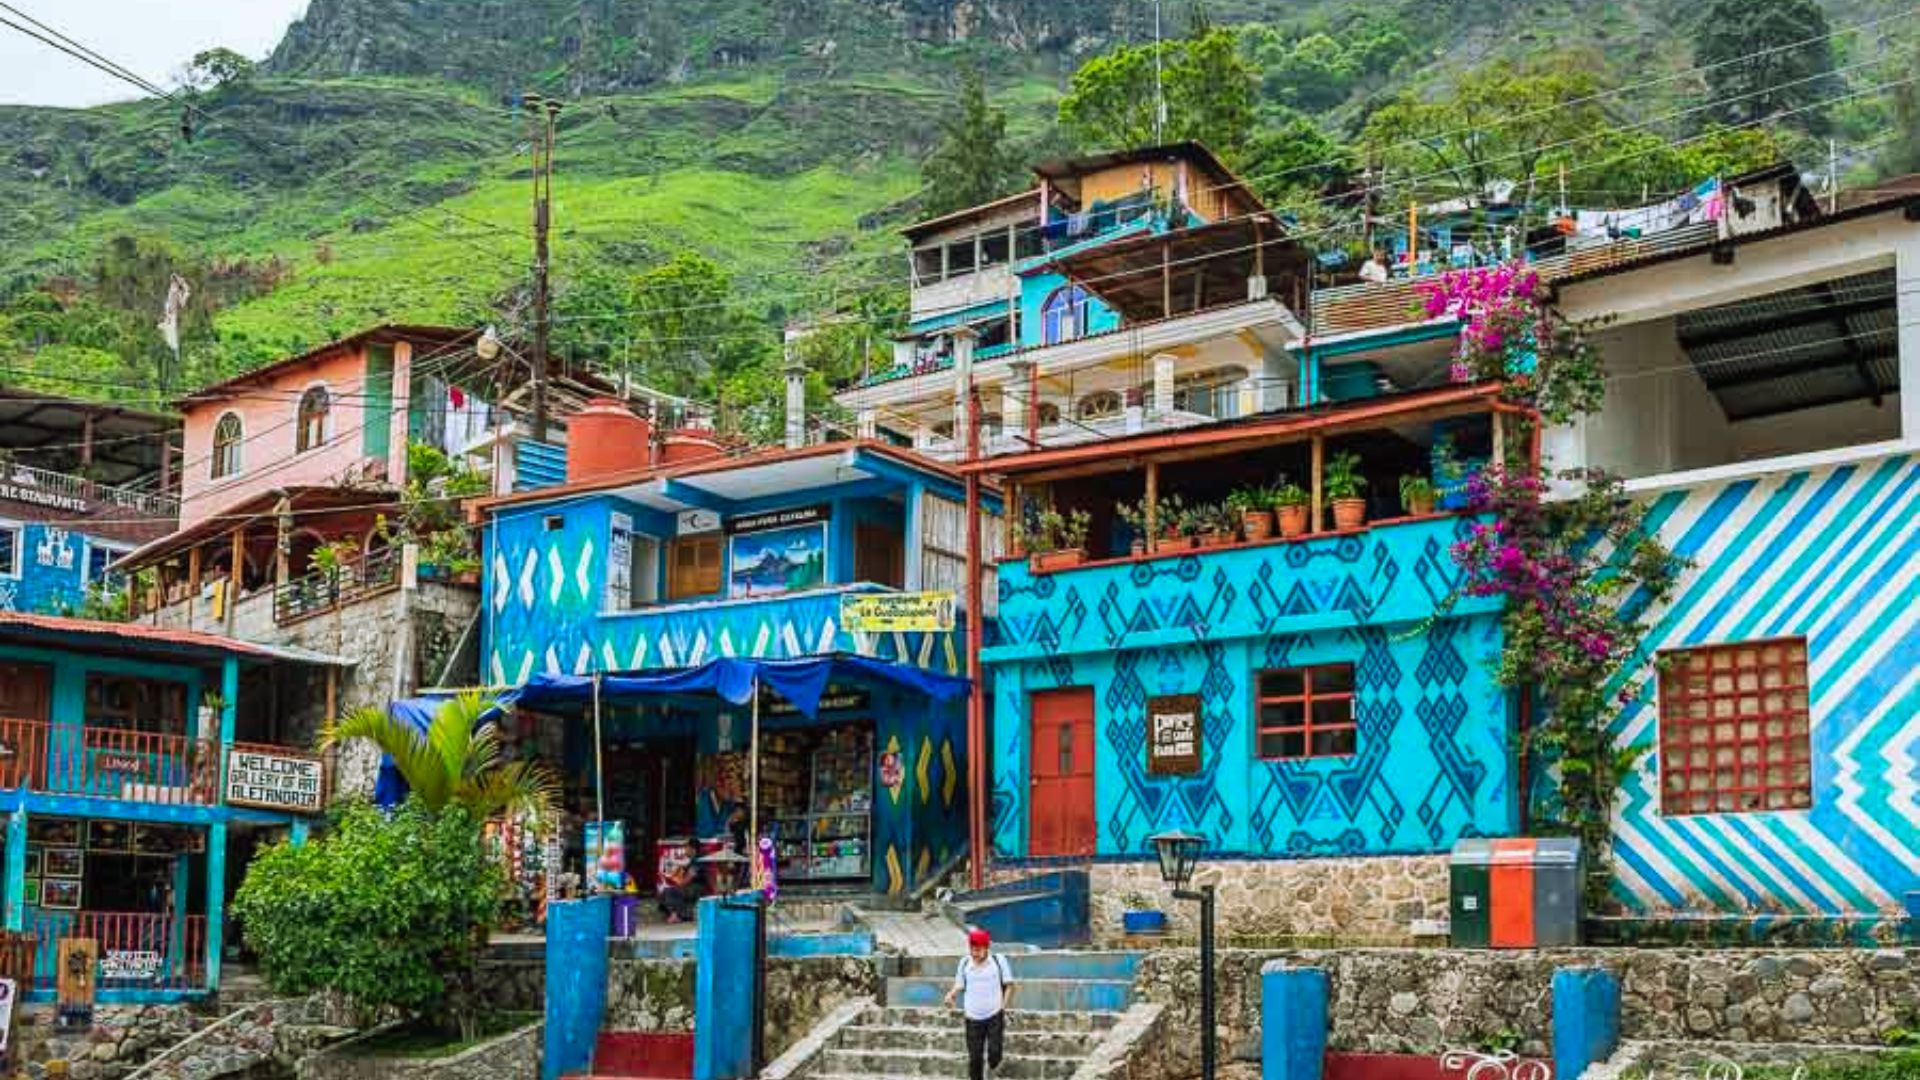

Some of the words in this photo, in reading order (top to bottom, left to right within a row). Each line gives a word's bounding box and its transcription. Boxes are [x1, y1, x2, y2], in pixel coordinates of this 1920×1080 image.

[238, 755, 314, 777] WELCOME
[230, 769, 280, 787] GALLERY
[231, 784, 317, 806] ALEJANDRIA
